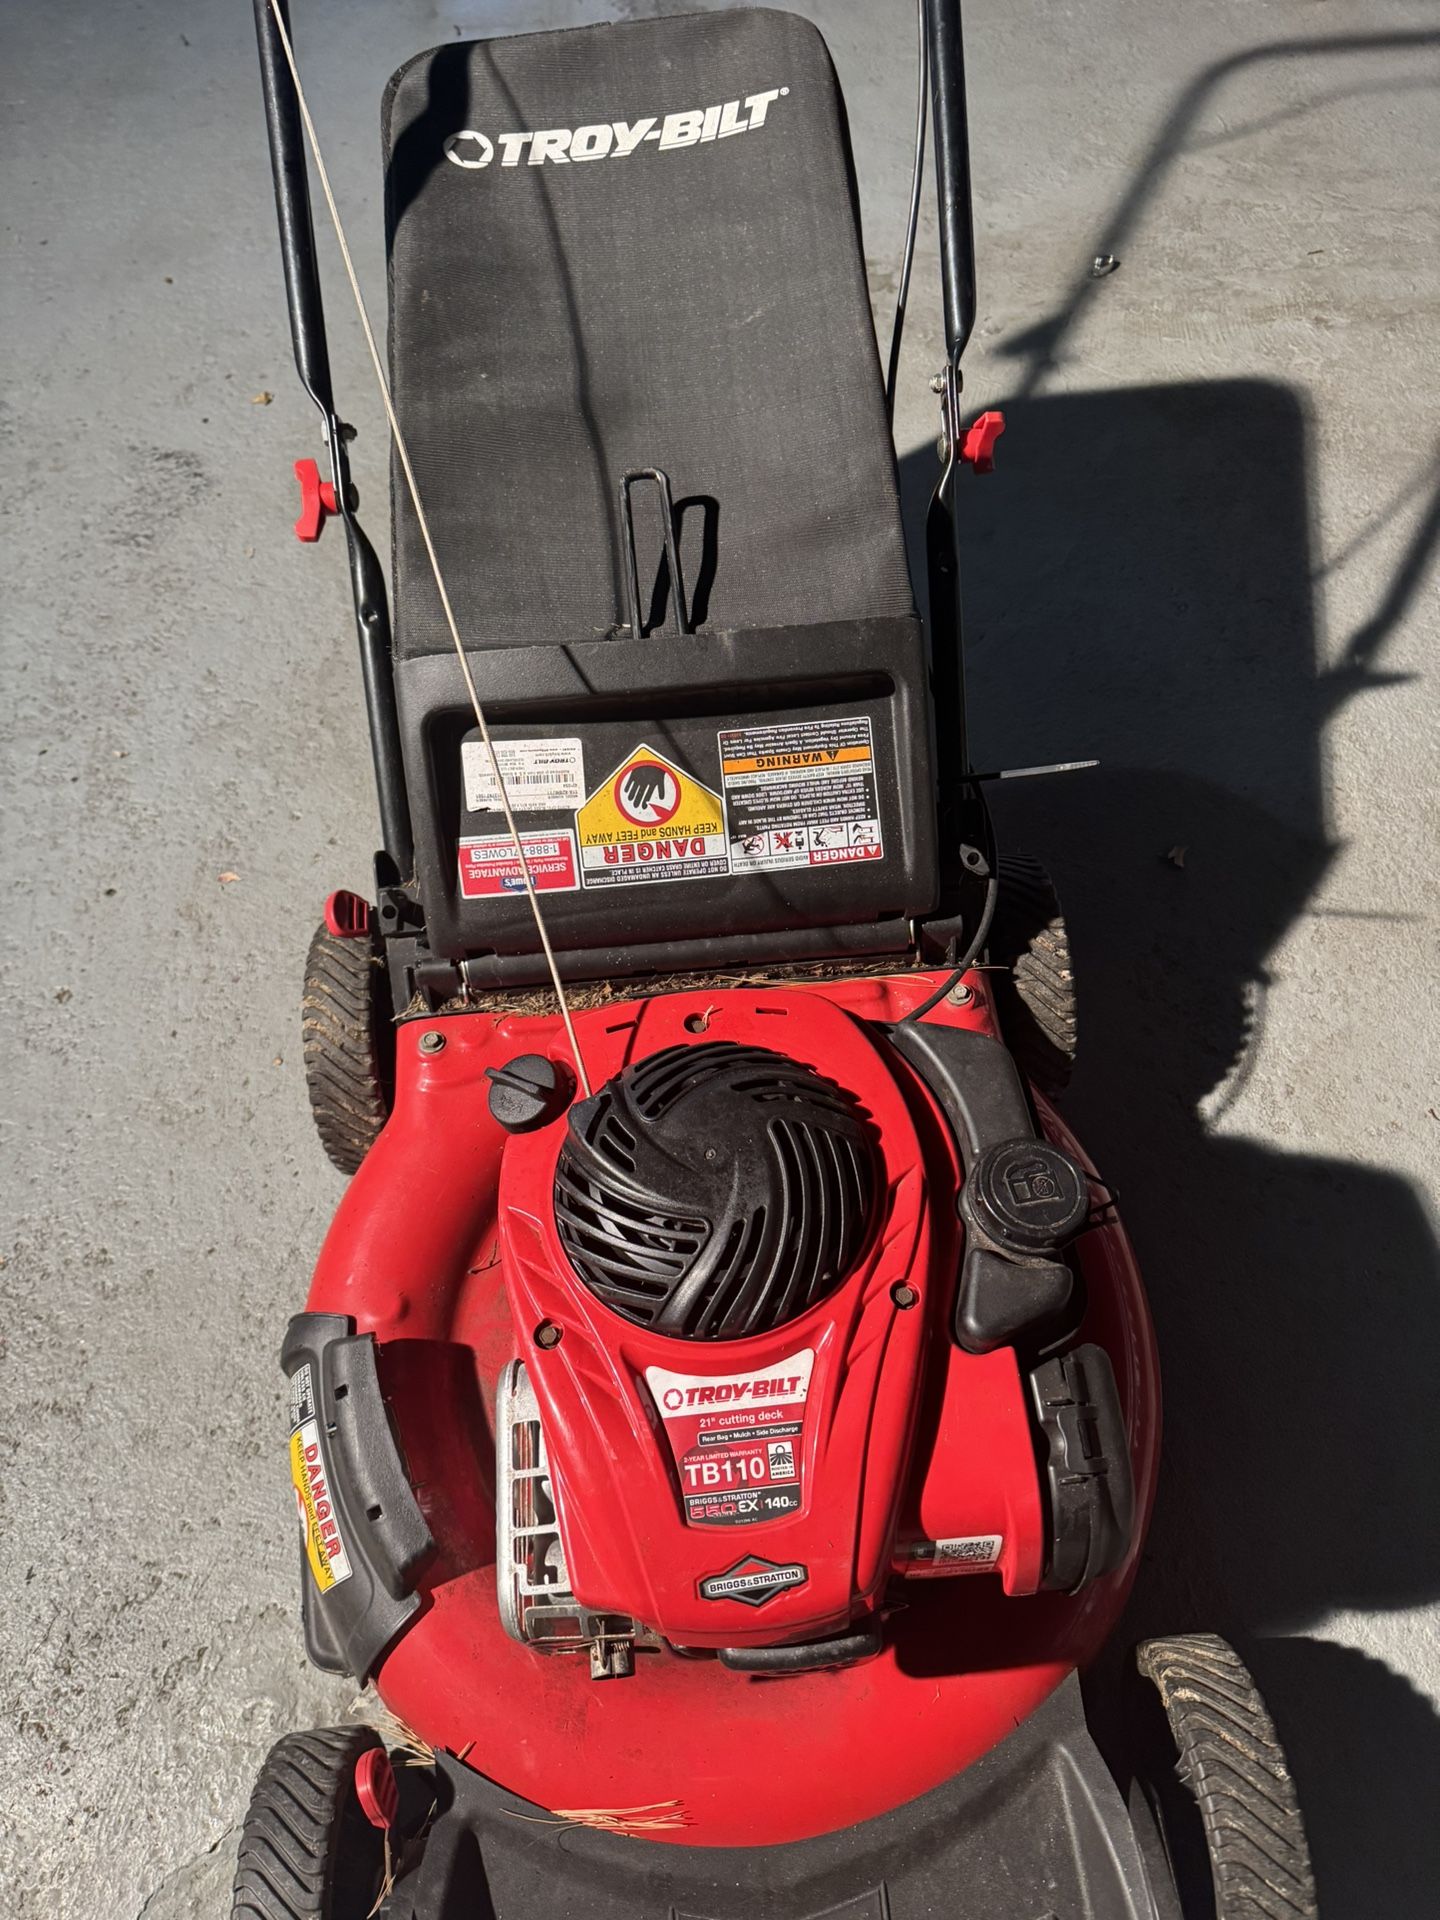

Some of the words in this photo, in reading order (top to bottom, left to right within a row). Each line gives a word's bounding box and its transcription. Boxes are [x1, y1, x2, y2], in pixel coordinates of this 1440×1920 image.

[497, 89, 780, 167] TROY-BILT
[755, 752, 822, 767] WARNING
[615, 829, 637, 841] FEET
[640, 827, 656, 838] and
[658, 824, 691, 837] HANDS
[693, 822, 717, 834] KEEP
[585, 832, 612, 844] AWAY
[602, 837, 706, 864] DANGER
[813, 846, 864, 861] DANGER
[527, 862, 567, 873] SERVICE
[641, 865, 665, 873] CATCHER
[709, 858, 726, 866] COVER
[467, 865, 524, 878] ADVANTAGE
[616, 872, 650, 881] UNDAMAGED
[660, 869, 681, 877] UNLESS
[682, 867, 706, 875] OPERATE
[586, 876, 615, 884] DISCHARGE
[686, 1376, 801, 1406] TROY-BILT
[700, 1418, 716, 1427] 21"
[719, 1413, 755, 1425] cutting
[758, 1410, 783, 1421] deck
[702, 1435, 716, 1443] Rear
[717, 1434, 729, 1442] Bag
[733, 1431, 751, 1439] Mulch
[756, 1429, 769, 1437] Side
[770, 1425, 798, 1436] Discharge
[296, 1436, 305, 1462] KEEP
[684, 1455, 704, 1463] 2-YEAR
[705, 1451, 729, 1460] LIMITED
[730, 1448, 763, 1458] WARRANTY
[685, 1458, 765, 1487] TB110
[300, 1464, 311, 1500] HANDS
[305, 1445, 342, 1561] DANGER
[307, 1502, 315, 1520] and
